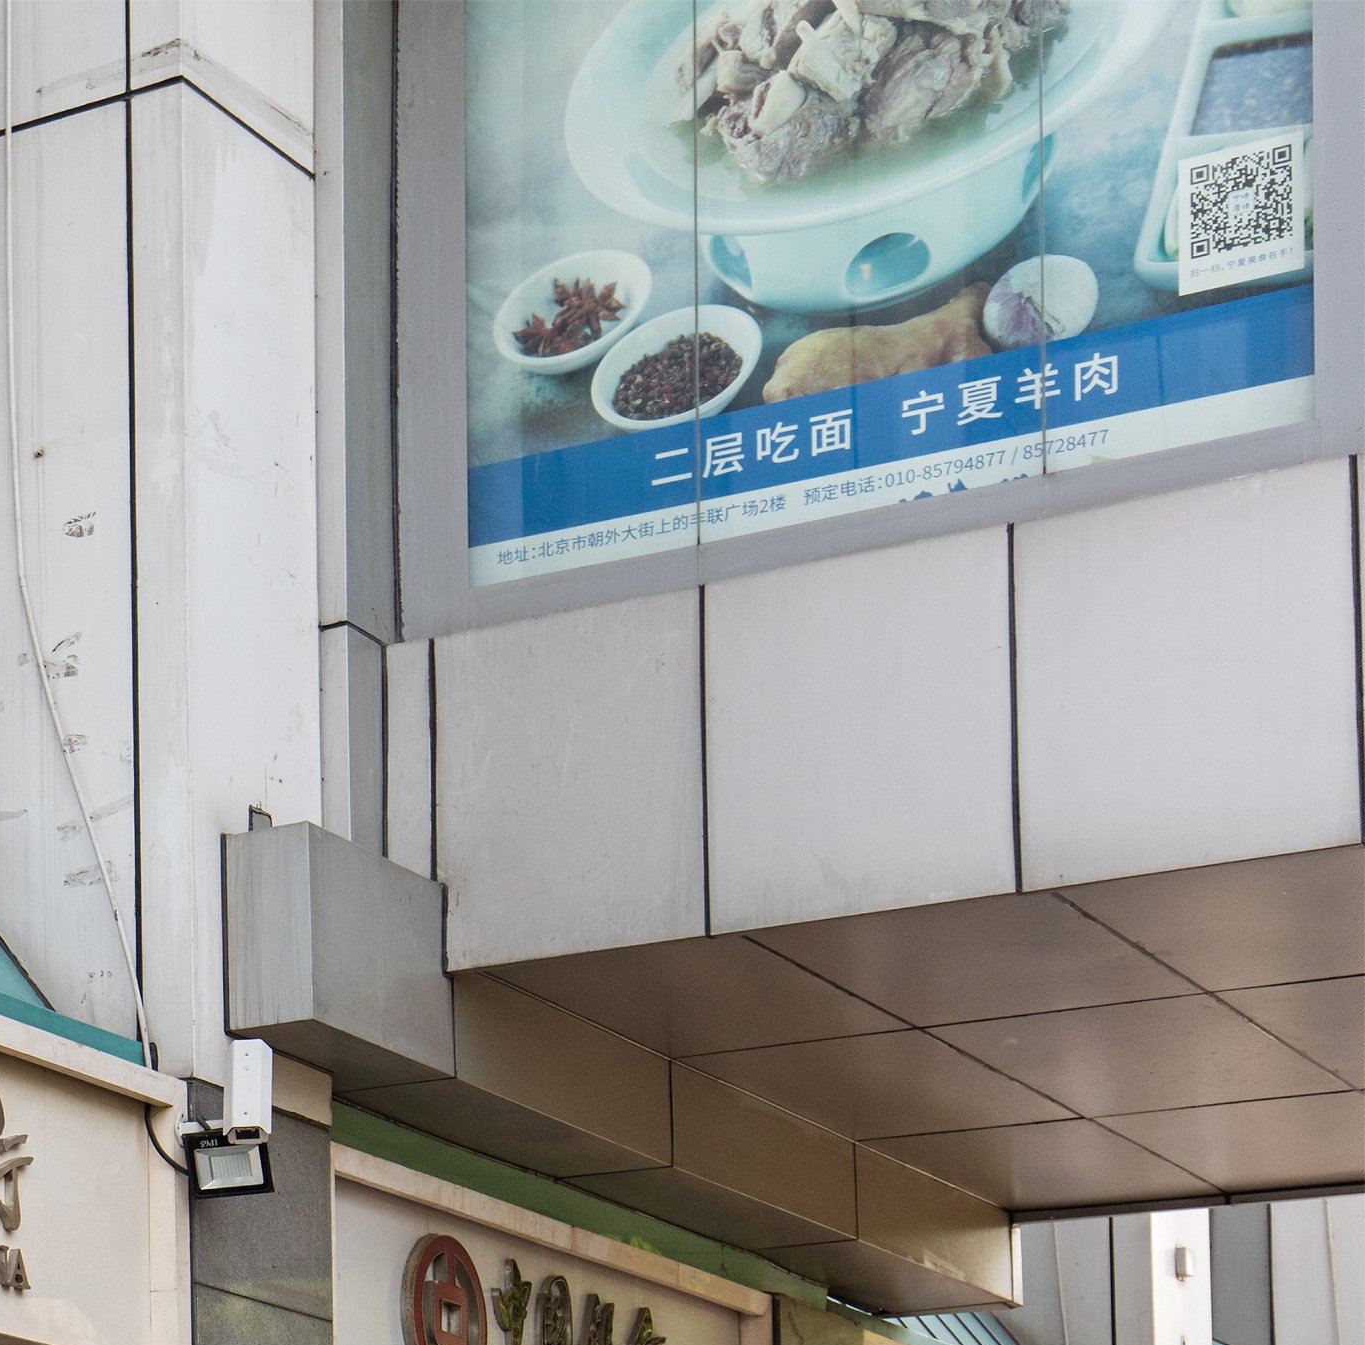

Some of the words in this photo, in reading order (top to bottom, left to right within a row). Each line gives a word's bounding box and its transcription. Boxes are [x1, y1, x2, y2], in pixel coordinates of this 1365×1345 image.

[651, 408, 853, 486] 二层吃面
[901, 352, 1120, 436] 宁夏羊肉
[1023, 429, 1109, 460] 85728477
